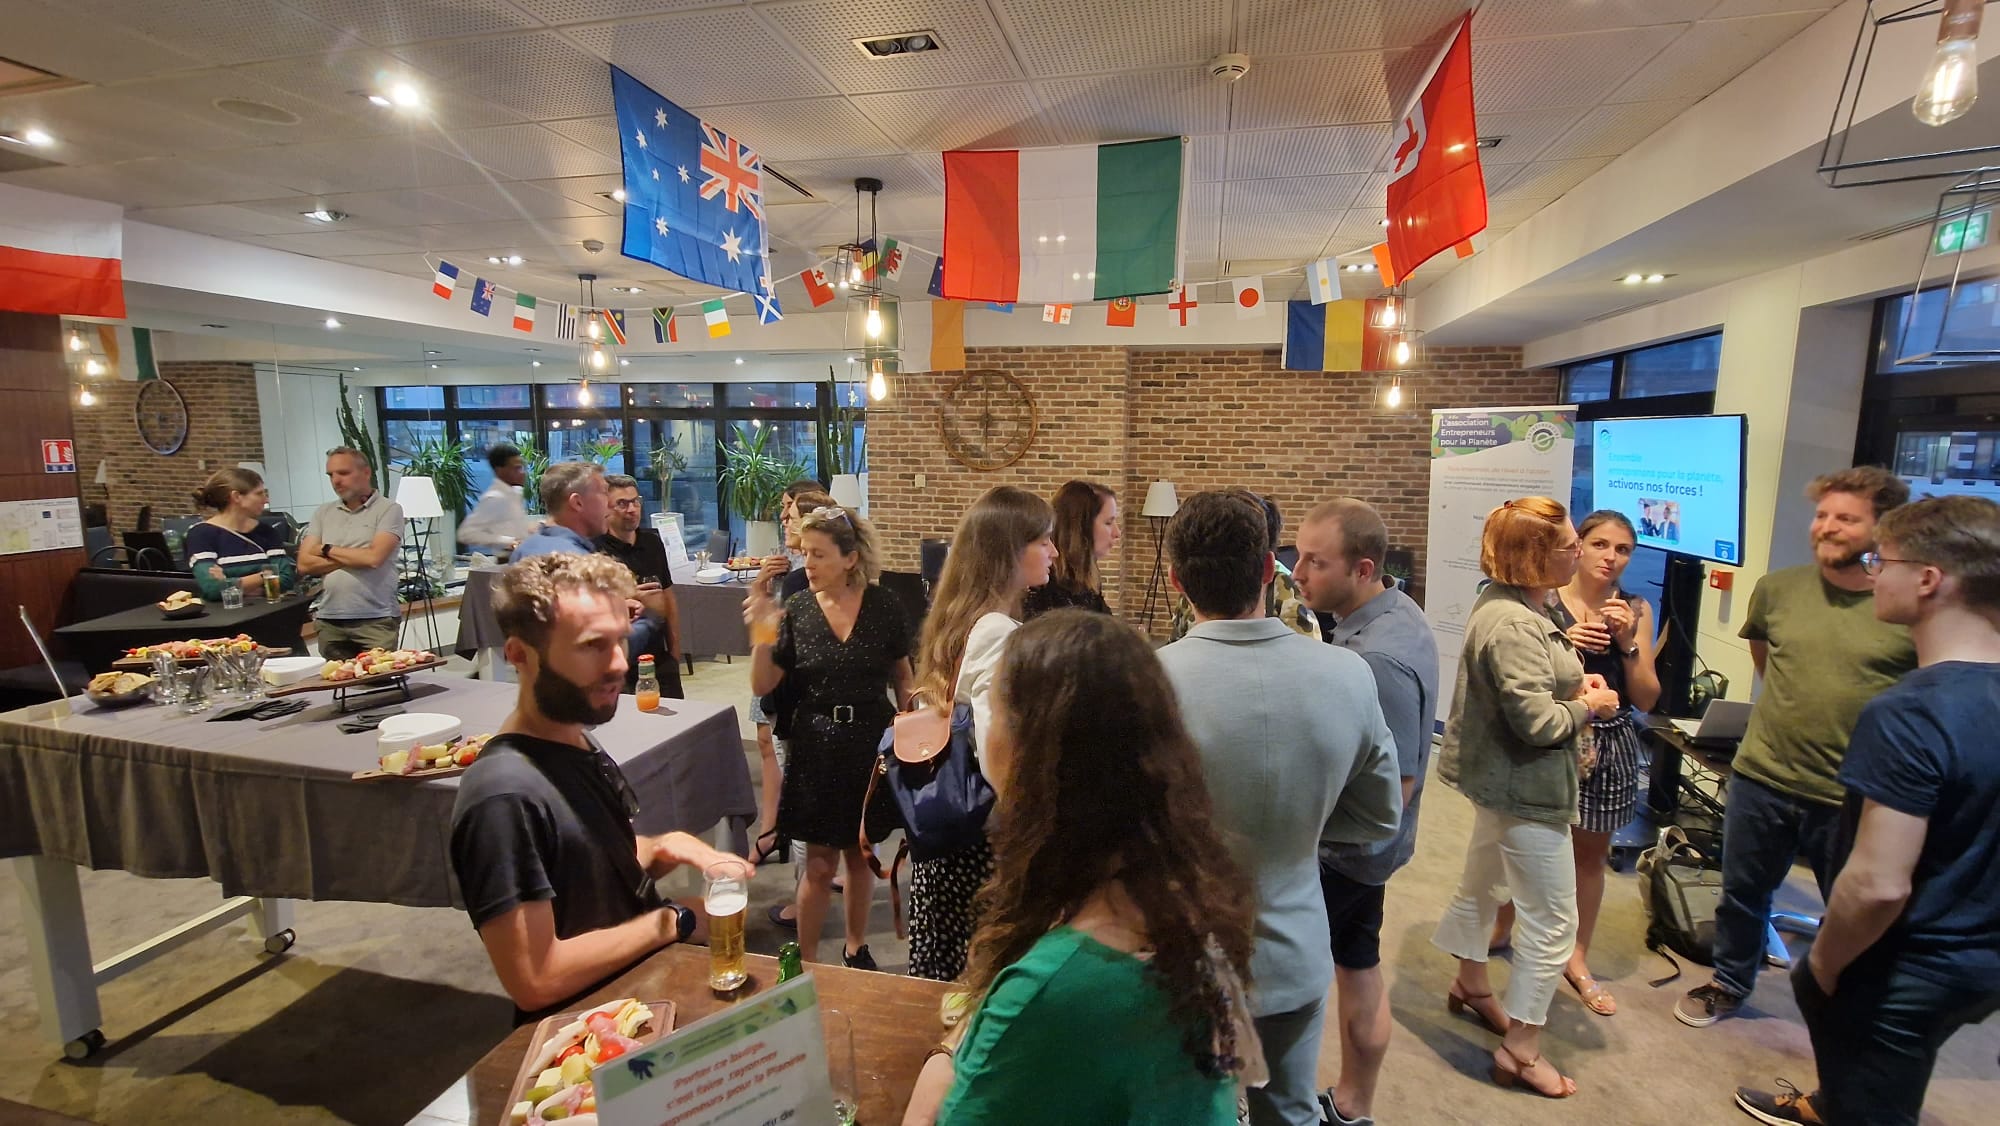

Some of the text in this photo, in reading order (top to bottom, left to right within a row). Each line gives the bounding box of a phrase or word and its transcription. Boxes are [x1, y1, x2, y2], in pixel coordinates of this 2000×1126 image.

[1441, 419, 1489, 427] L'association
[1440, 429, 1496, 438] Entrepreneurs
[1459, 438, 1467, 446] la
[1468, 438, 1498, 446] Planète
[1657, 470, 1676, 480] pour
[1608, 477, 1645, 491] activons
[1646, 482, 1663, 493] nos
[1665, 482, 1697, 496] forces
[725, 1080, 752, 1101] pour
